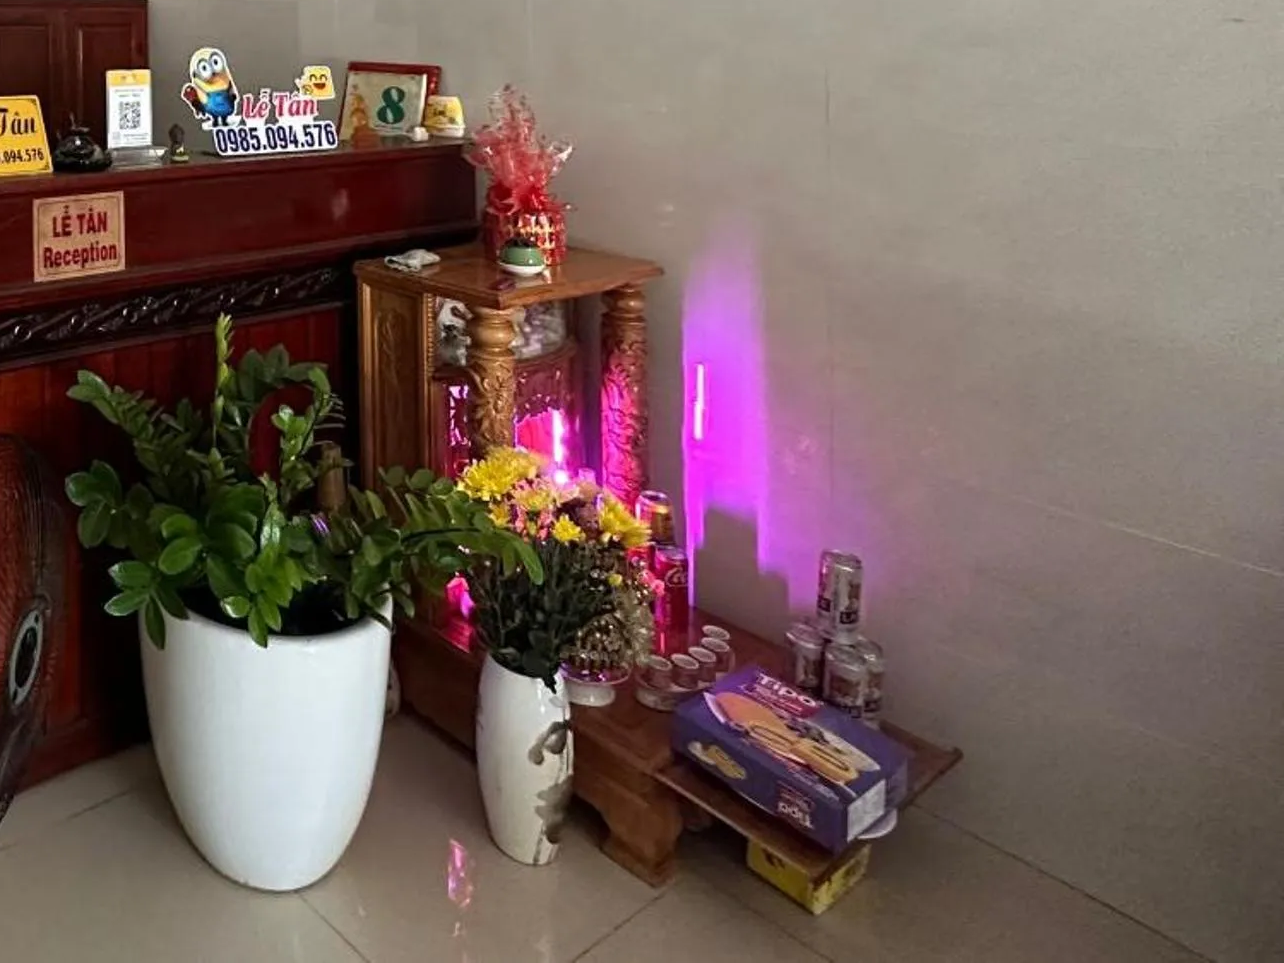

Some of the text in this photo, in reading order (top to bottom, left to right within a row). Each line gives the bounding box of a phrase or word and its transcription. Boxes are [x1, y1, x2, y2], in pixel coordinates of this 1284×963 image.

[241, 88, 271, 120] Lễ
[377, 85, 406, 125] 8
[215, 122, 337, 154] 0985.094.576
[43, 240, 118, 269] Reception
[757, 671, 817, 708] Tipo
